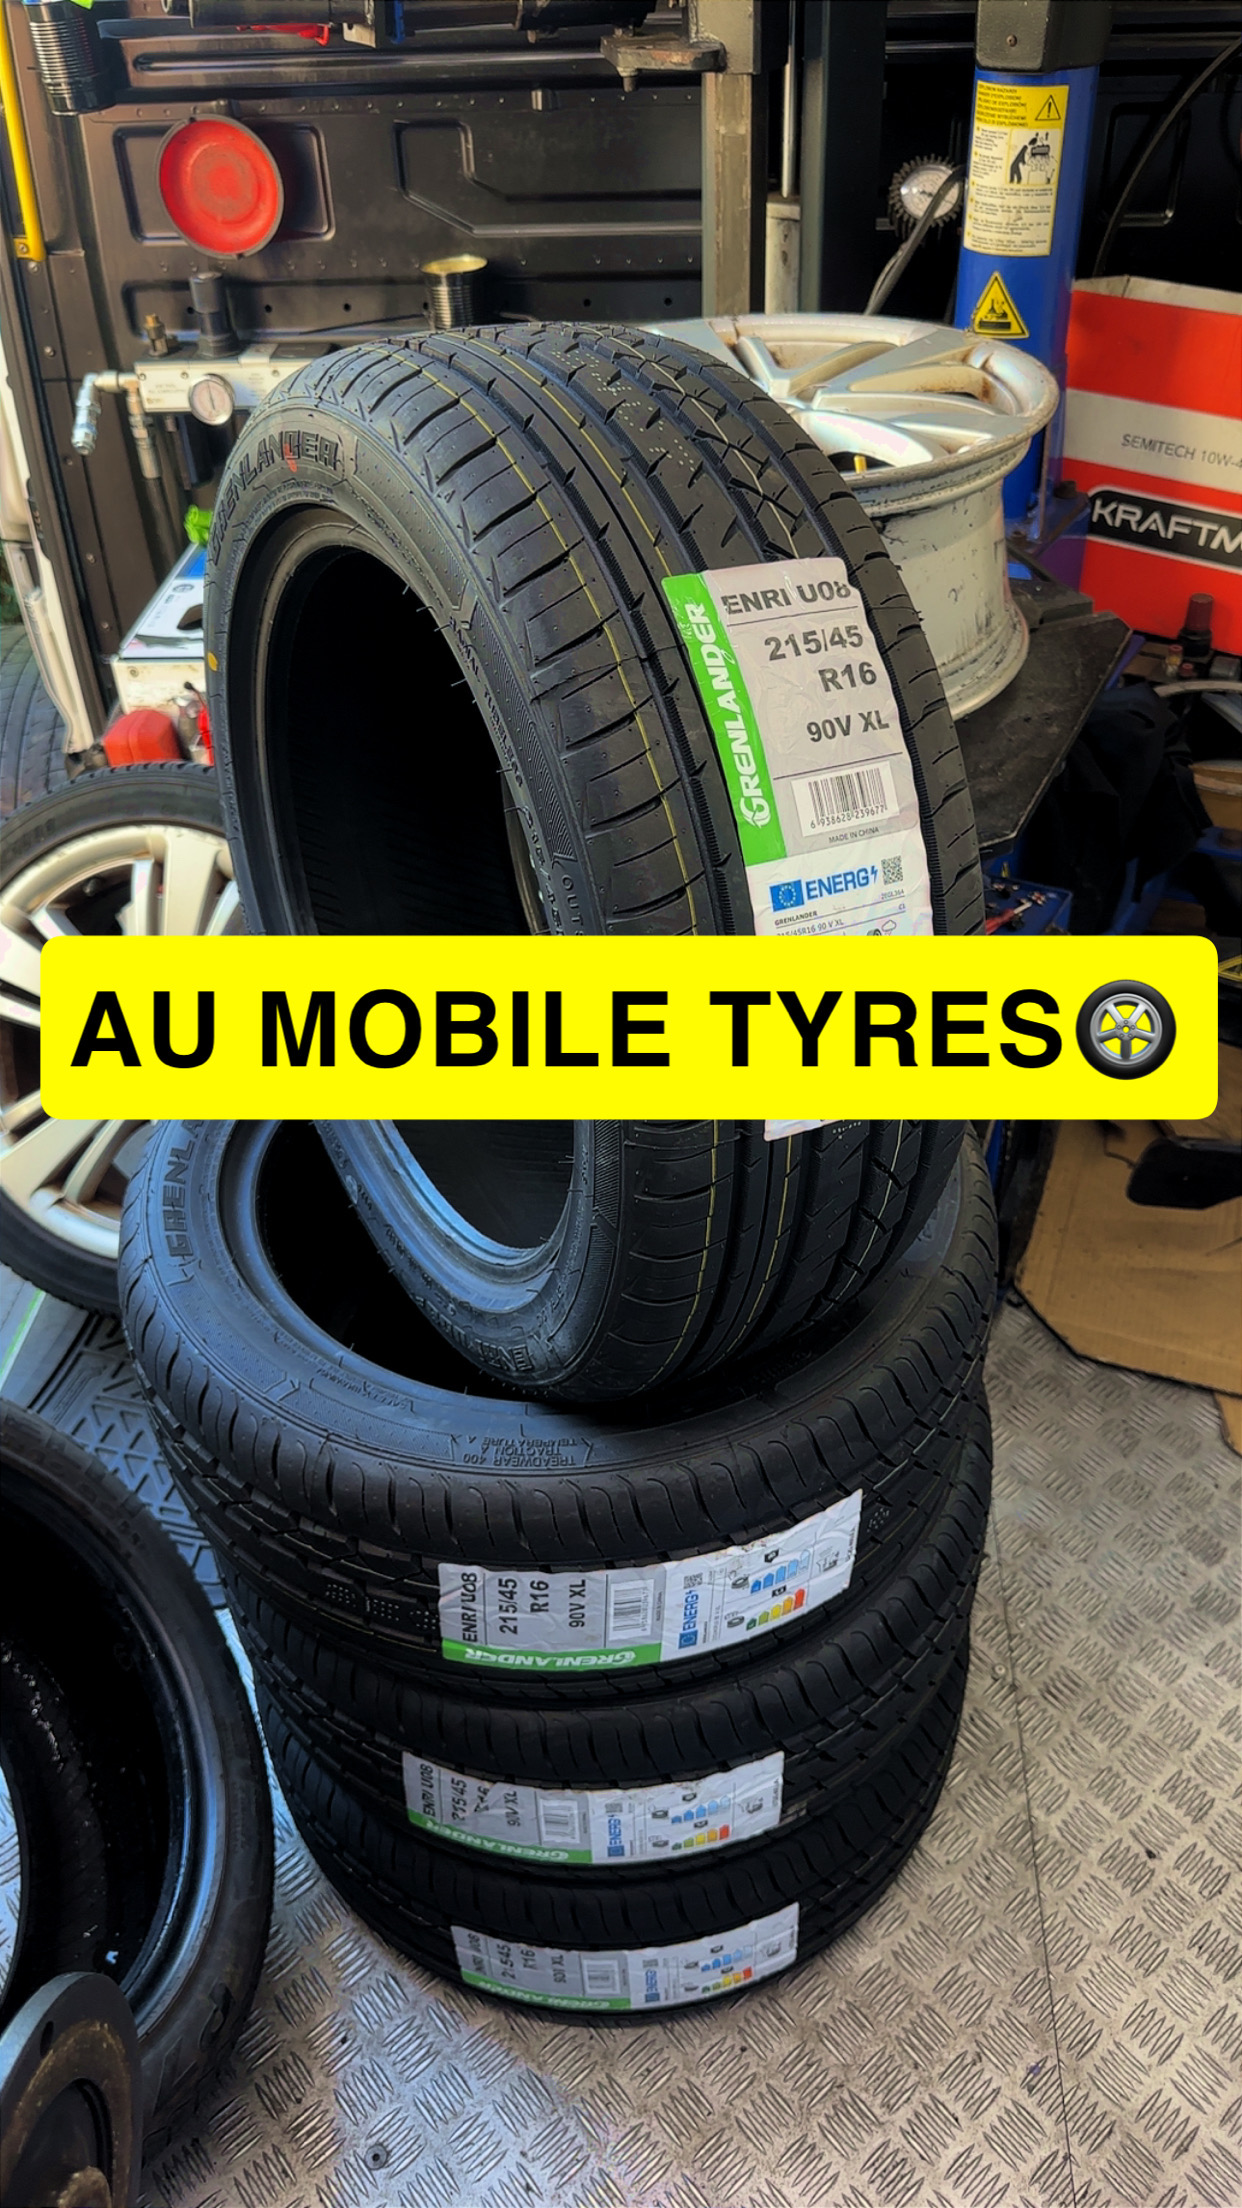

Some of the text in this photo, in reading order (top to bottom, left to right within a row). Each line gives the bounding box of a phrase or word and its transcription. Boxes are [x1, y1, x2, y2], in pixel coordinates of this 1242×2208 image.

[1121, 433, 1195, 460] SEMITECH
[721, 580, 851, 615] ENRI U08
[764, 625, 863, 661] 215/45
[818, 661, 877, 692] R16
[687, 602, 771, 828] GRENLANDER
[807, 710, 890, 742] 90V XL
[828, 827, 880, 844] MADE IN CHINA
[775, 910, 818, 926] GRENLANDER
[493, 1454, 576, 1467] TREADWEAR
[495, 1446, 562, 1456] TRACTION
[461, 1572, 478, 1643] ENRI U08
[498, 1578, 518, 1635] 215/45
[530, 1580, 549, 1613] R16
[569, 1579, 586, 1628] 90V XL
[465, 1648, 636, 1667] GRENLANDER
[420, 1763, 436, 1817] ENRI U08
[426, 1819, 569, 1862] GRENLANDER
